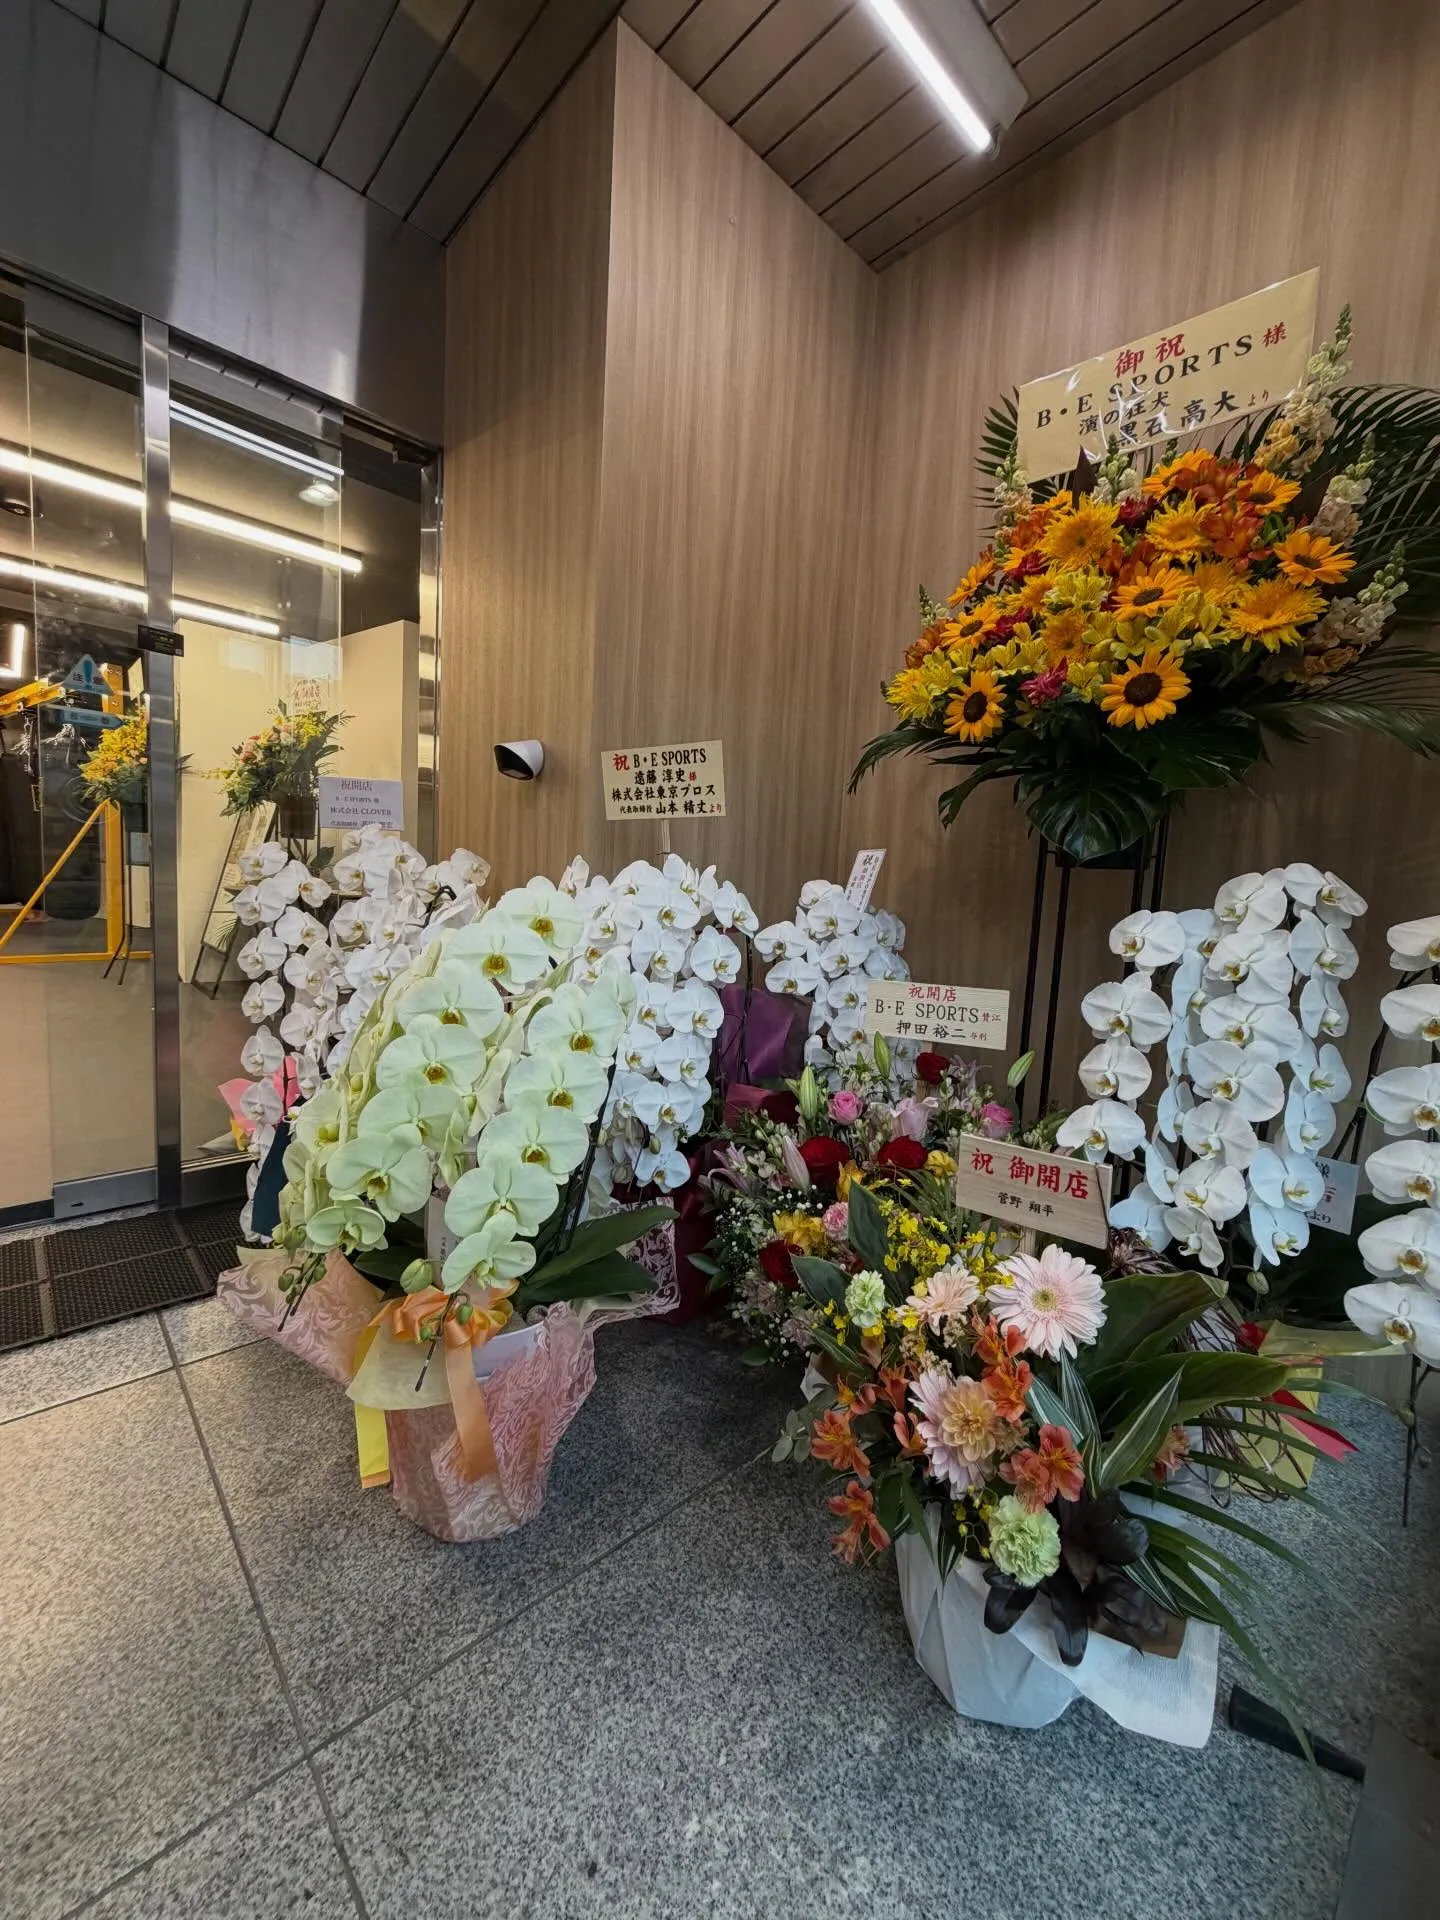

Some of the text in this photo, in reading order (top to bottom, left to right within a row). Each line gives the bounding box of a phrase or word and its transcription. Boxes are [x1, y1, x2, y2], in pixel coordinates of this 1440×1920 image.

[1108, 334, 1253, 404] SPORTS
[1261, 321, 1288, 347] 様
[1113, 333, 1185, 379] 御祝
[1246, 390, 1271, 408] より
[613, 753, 630, 772] 祝
[661, 748, 707, 766] SPORTS
[634, 769, 657, 785] 遠藤
[688, 771, 697, 782] 様
[360, 807, 392, 816] CLOVER
[655, 799, 679, 815] 山本
[709, 803, 721, 814] より
[908, 983, 957, 1002] 祝開店
[915, 1002, 979, 1024] SPORTS
[896, 1019, 928, 1036] 押田
[932, 1023, 966, 1039] 裕二
[971, 1147, 1089, 1200] 祝 御開店
[1028, 1200, 1055, 1217] 翔平
